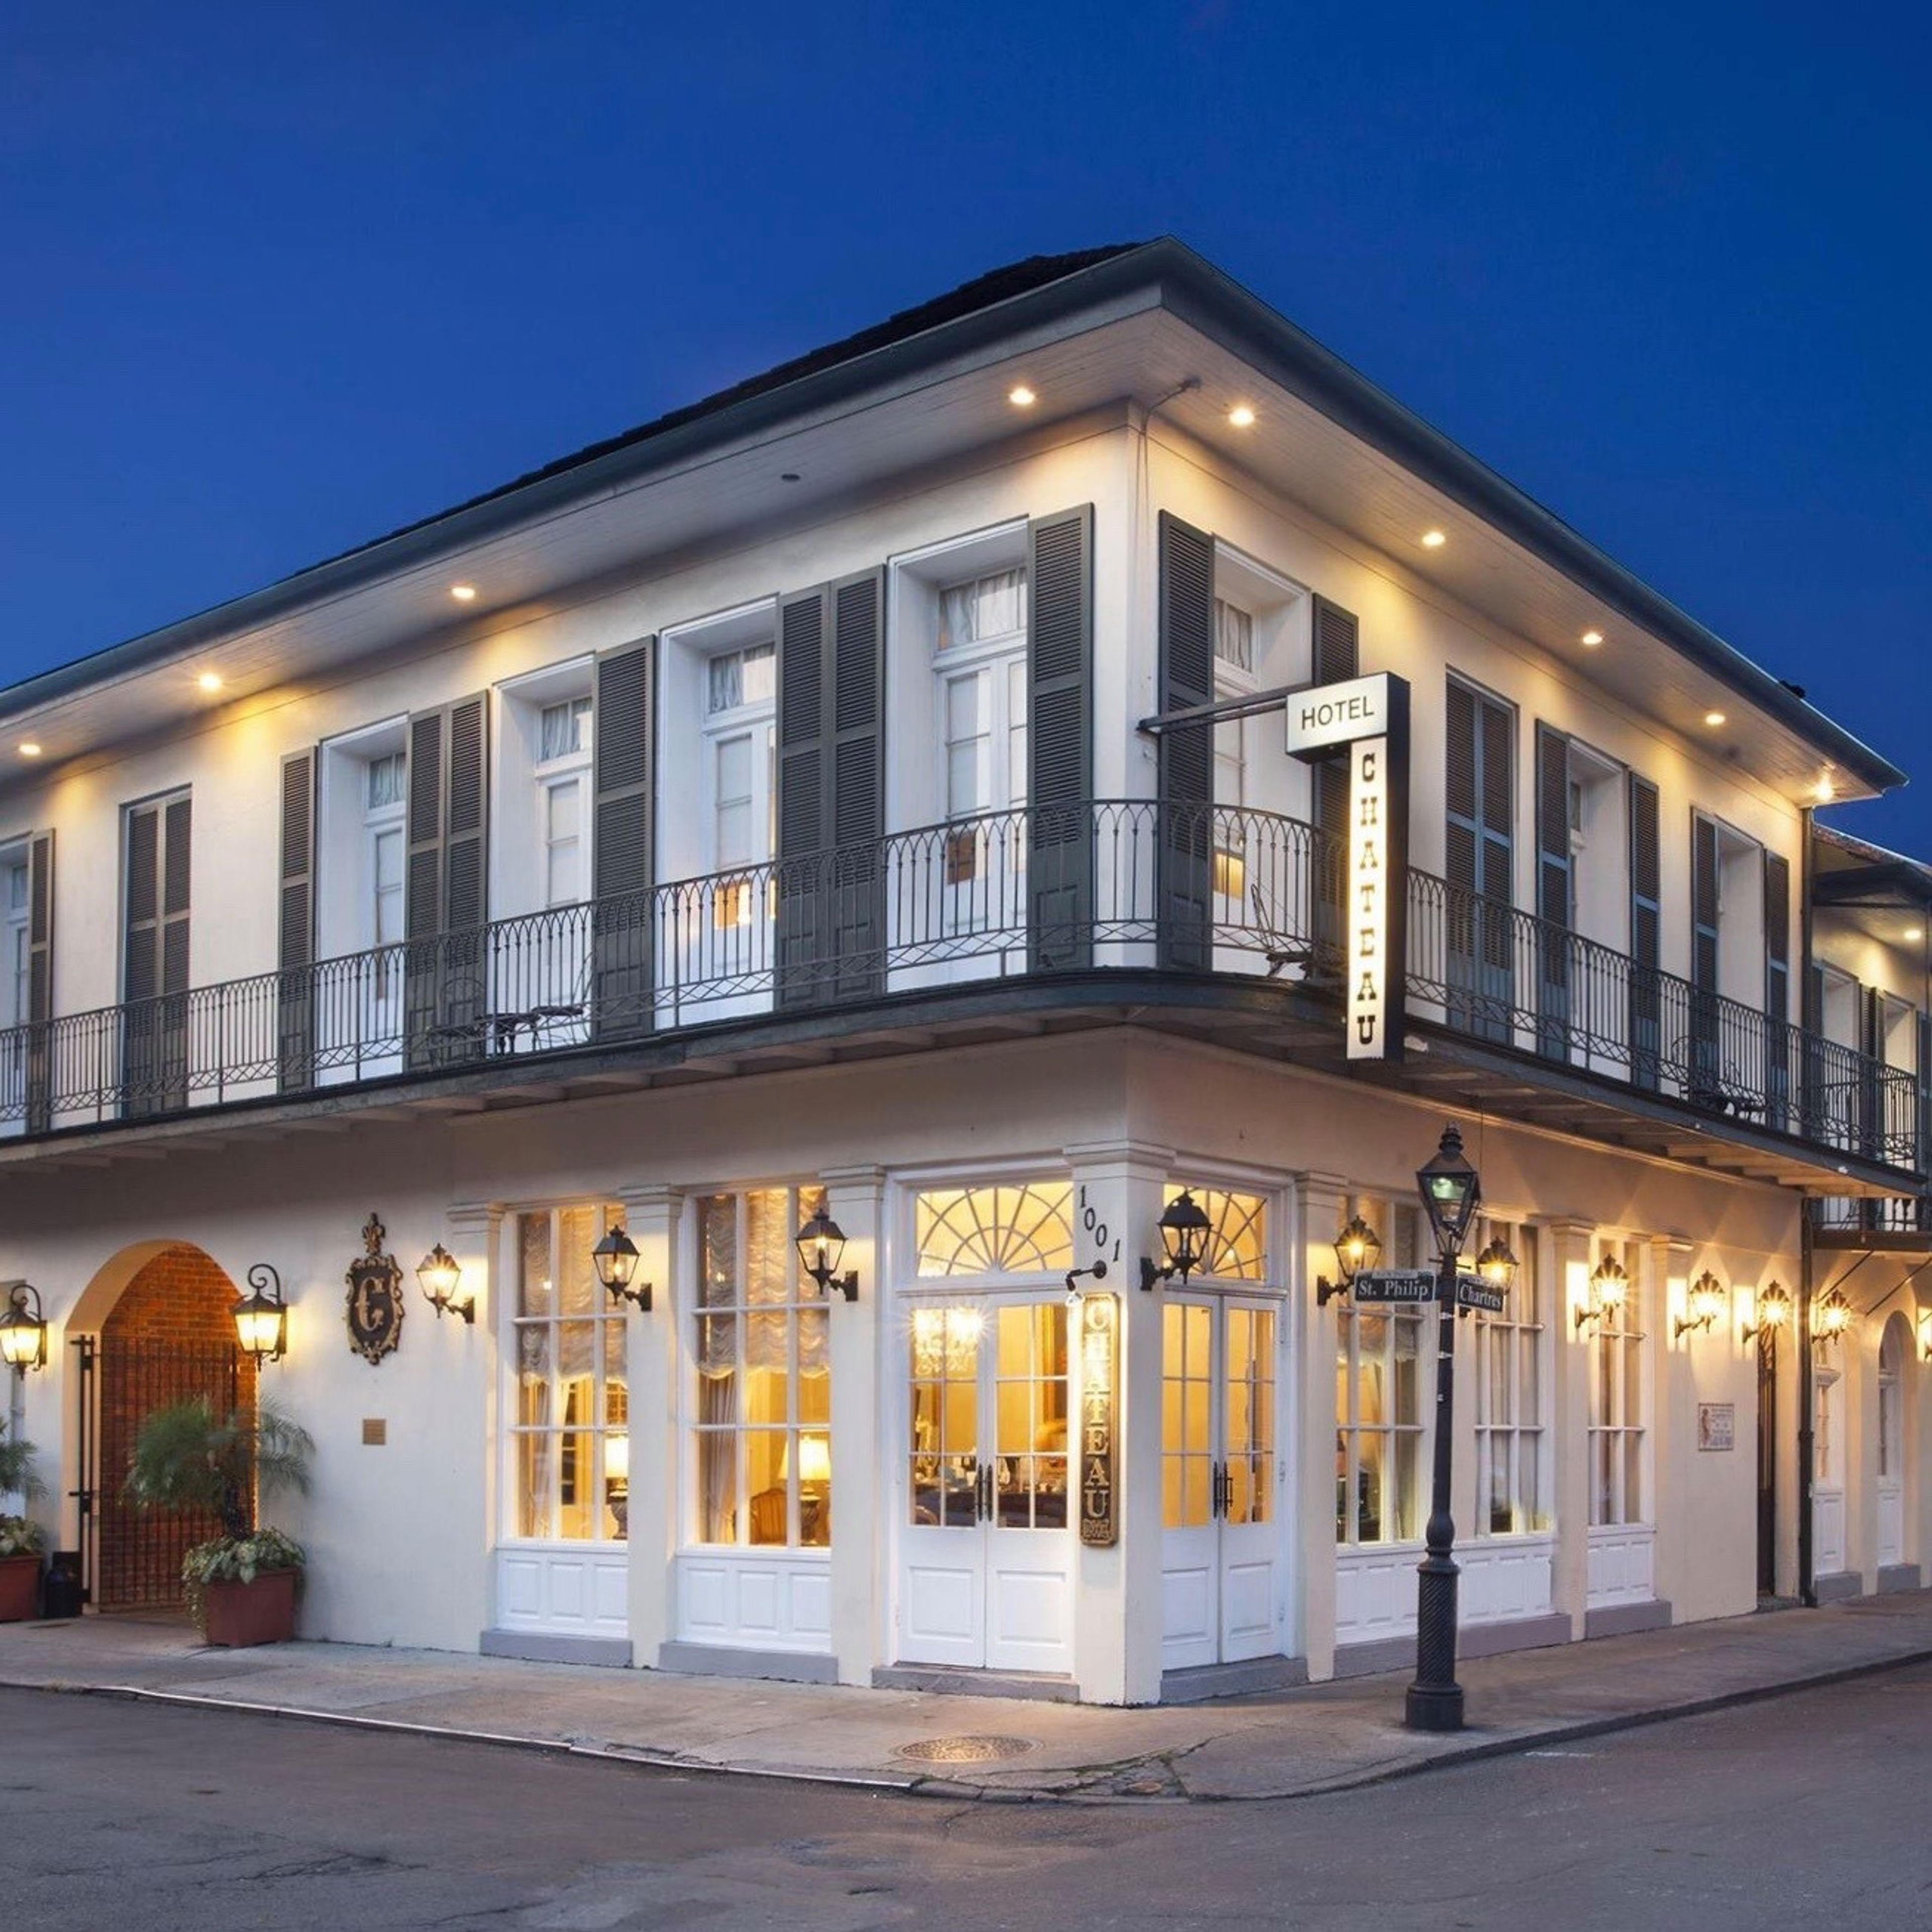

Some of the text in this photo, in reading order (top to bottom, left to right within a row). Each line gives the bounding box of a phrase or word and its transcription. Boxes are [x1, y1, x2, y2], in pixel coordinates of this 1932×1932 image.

[1302, 696, 1374, 731] HOTEL
[1357, 753, 1378, 1044] CHATEAU
[1080, 1185, 1120, 1262] 1001
[1359, 1280, 1428, 1302] St. Philip
[1460, 1284, 1501, 1308] Chartres
